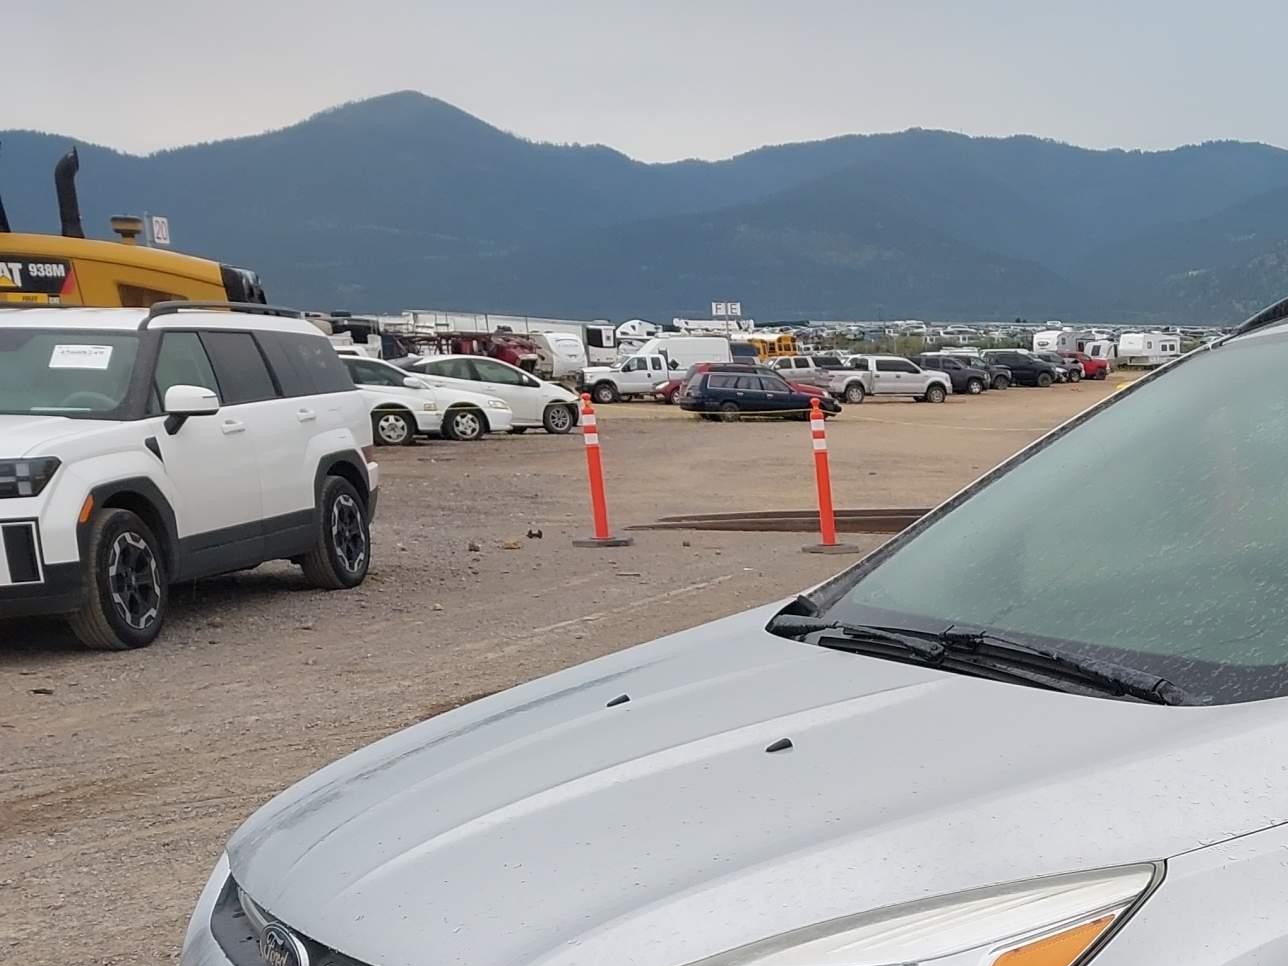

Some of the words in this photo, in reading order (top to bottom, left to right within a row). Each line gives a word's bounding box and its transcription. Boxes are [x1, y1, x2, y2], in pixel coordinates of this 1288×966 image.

[154, 219, 167, 240] 20
[28, 263, 65, 277] 938M
[715, 303, 722, 314] F
[730, 303, 737, 314] E
